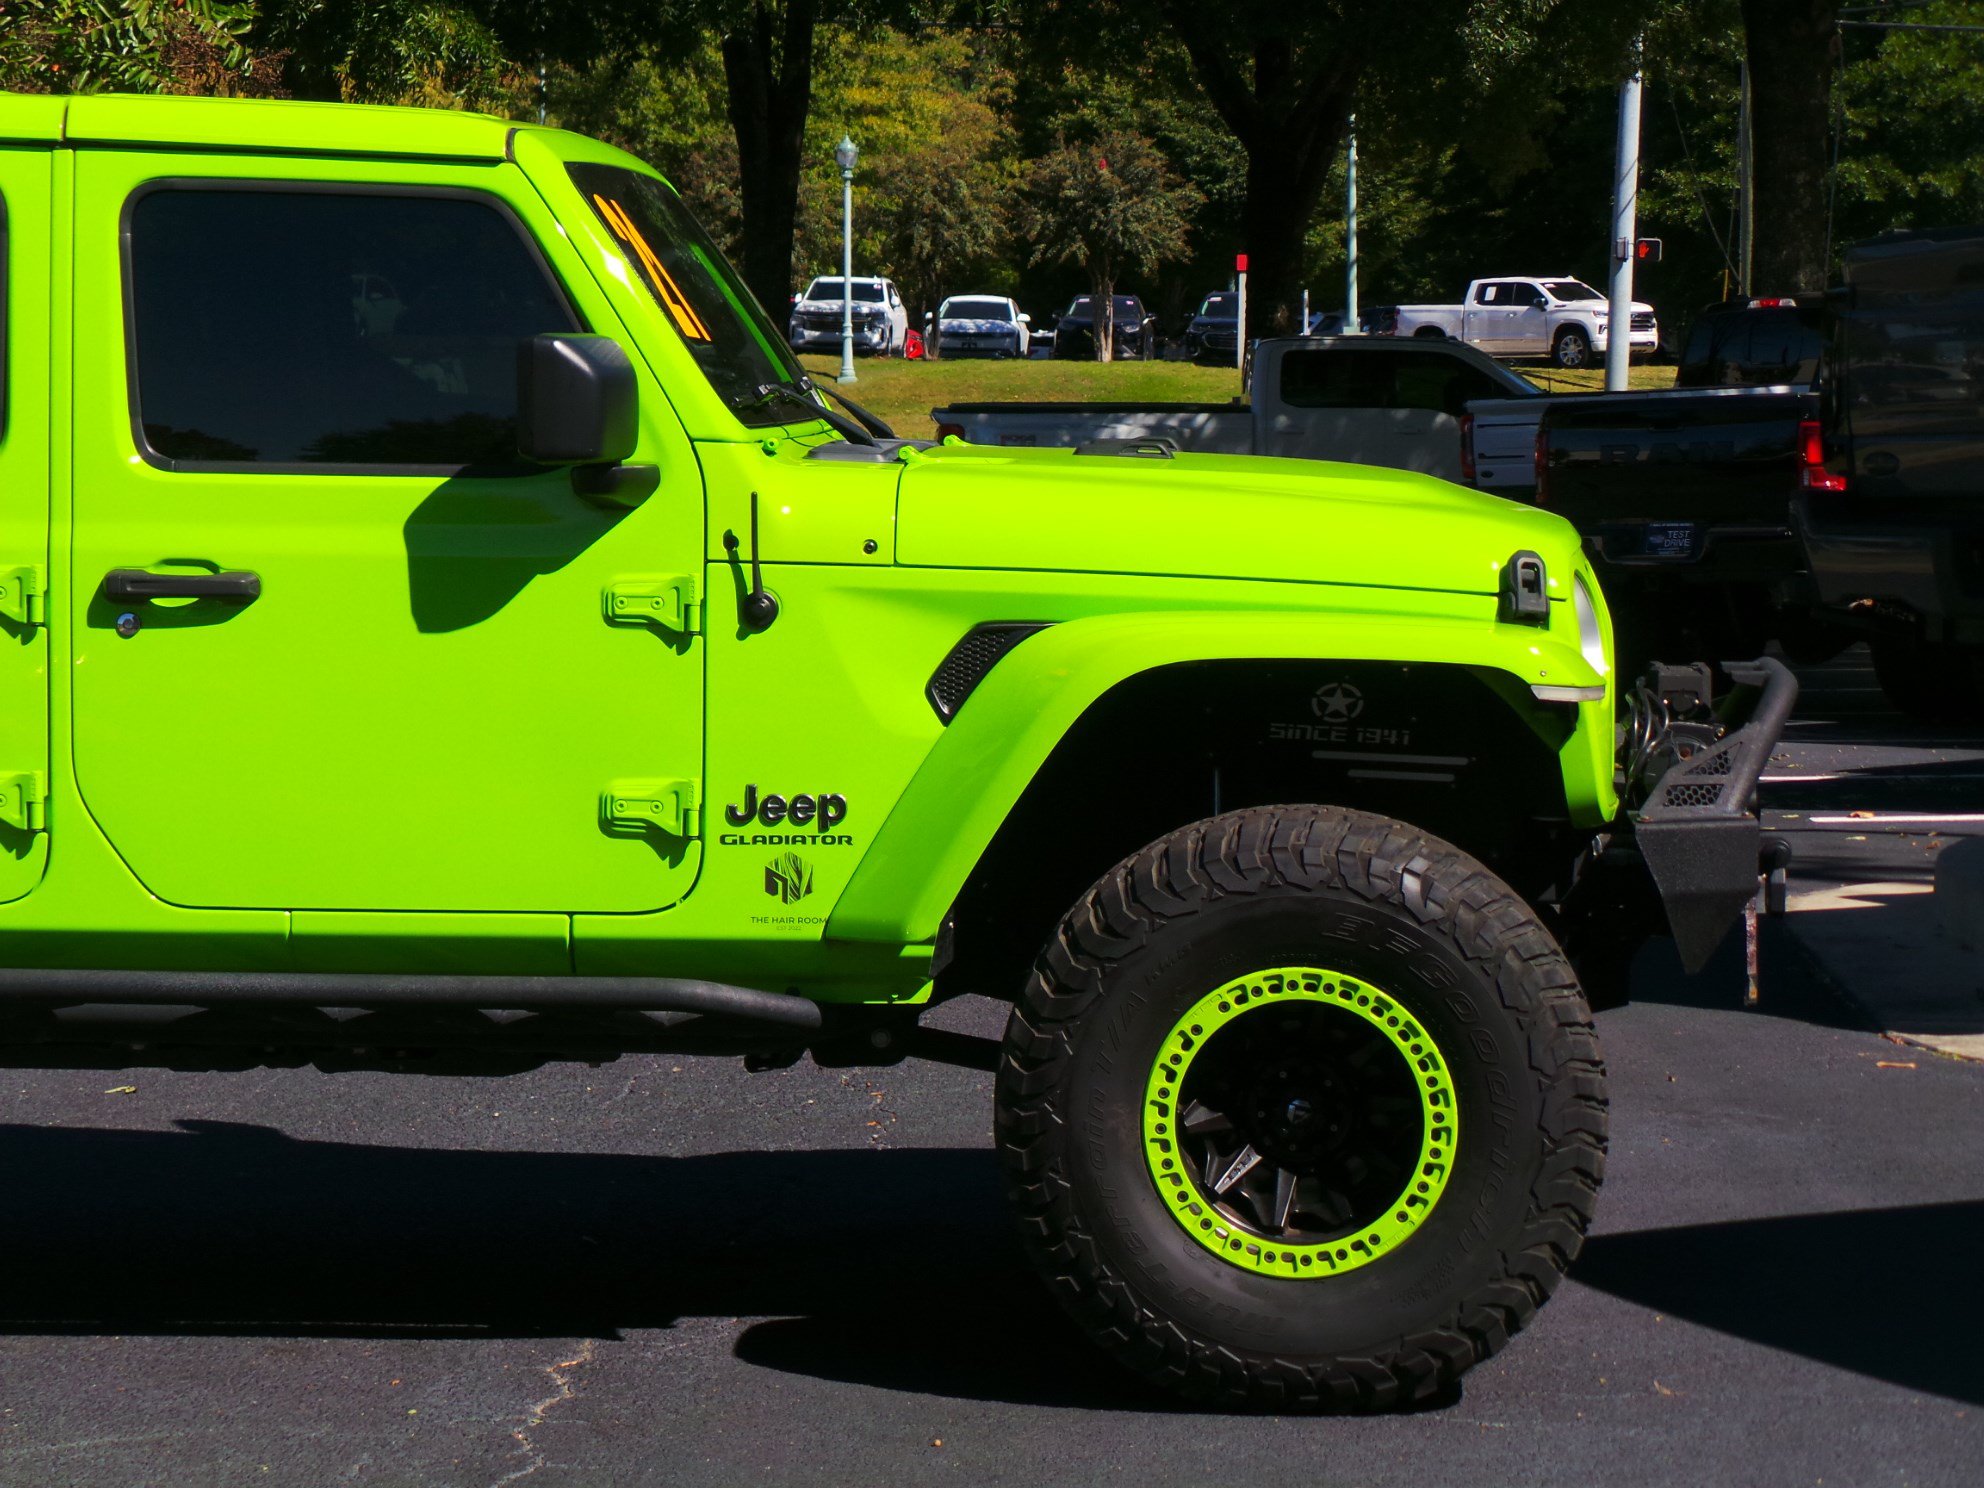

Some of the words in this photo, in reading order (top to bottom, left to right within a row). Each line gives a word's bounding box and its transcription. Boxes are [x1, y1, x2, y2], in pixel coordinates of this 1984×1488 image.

[1667, 530, 1692, 539] TEST
[1663, 538, 1692, 548] DRIVE
[1356, 727, 1411, 746] 1941
[726, 784, 847, 834] Jeep
[719, 834, 853, 846] GLADIATOR
[751, 916, 769, 924] THE
[772, 916, 795, 924] HAIR
[798, 916, 827, 924] ROOM
